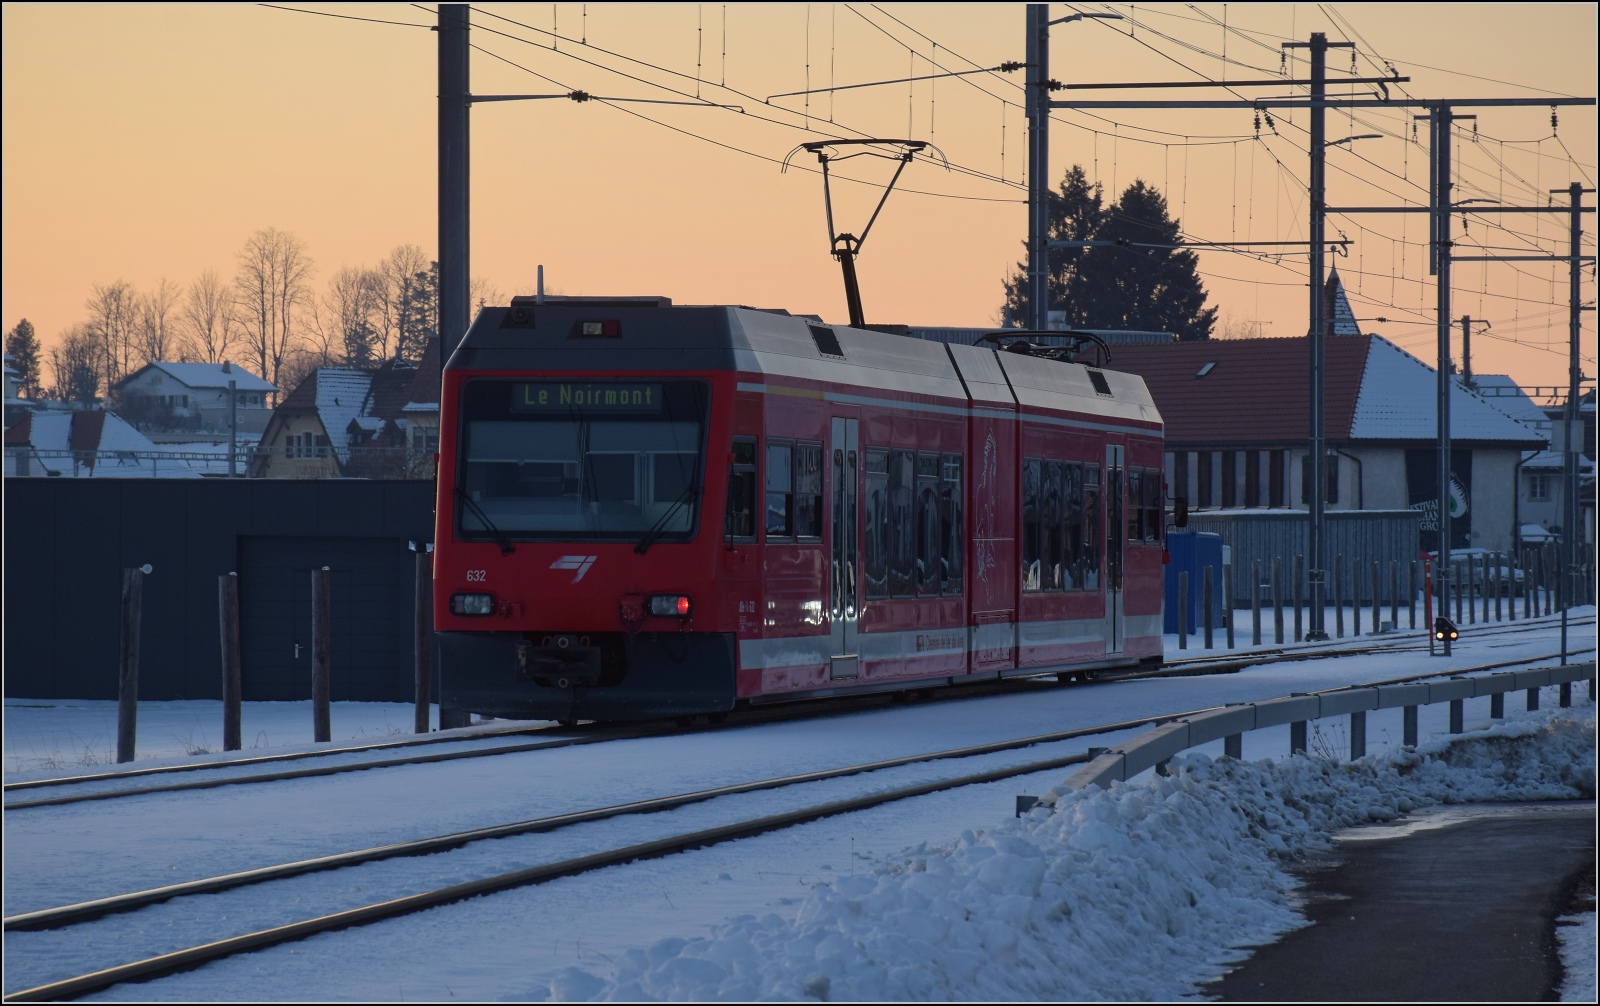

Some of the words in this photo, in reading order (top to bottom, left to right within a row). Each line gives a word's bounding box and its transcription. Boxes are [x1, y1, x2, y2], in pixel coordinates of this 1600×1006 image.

[525, 384, 548, 405] Le
[559, 384, 652, 405] Noirmont
[466, 569, 487, 582] 632
